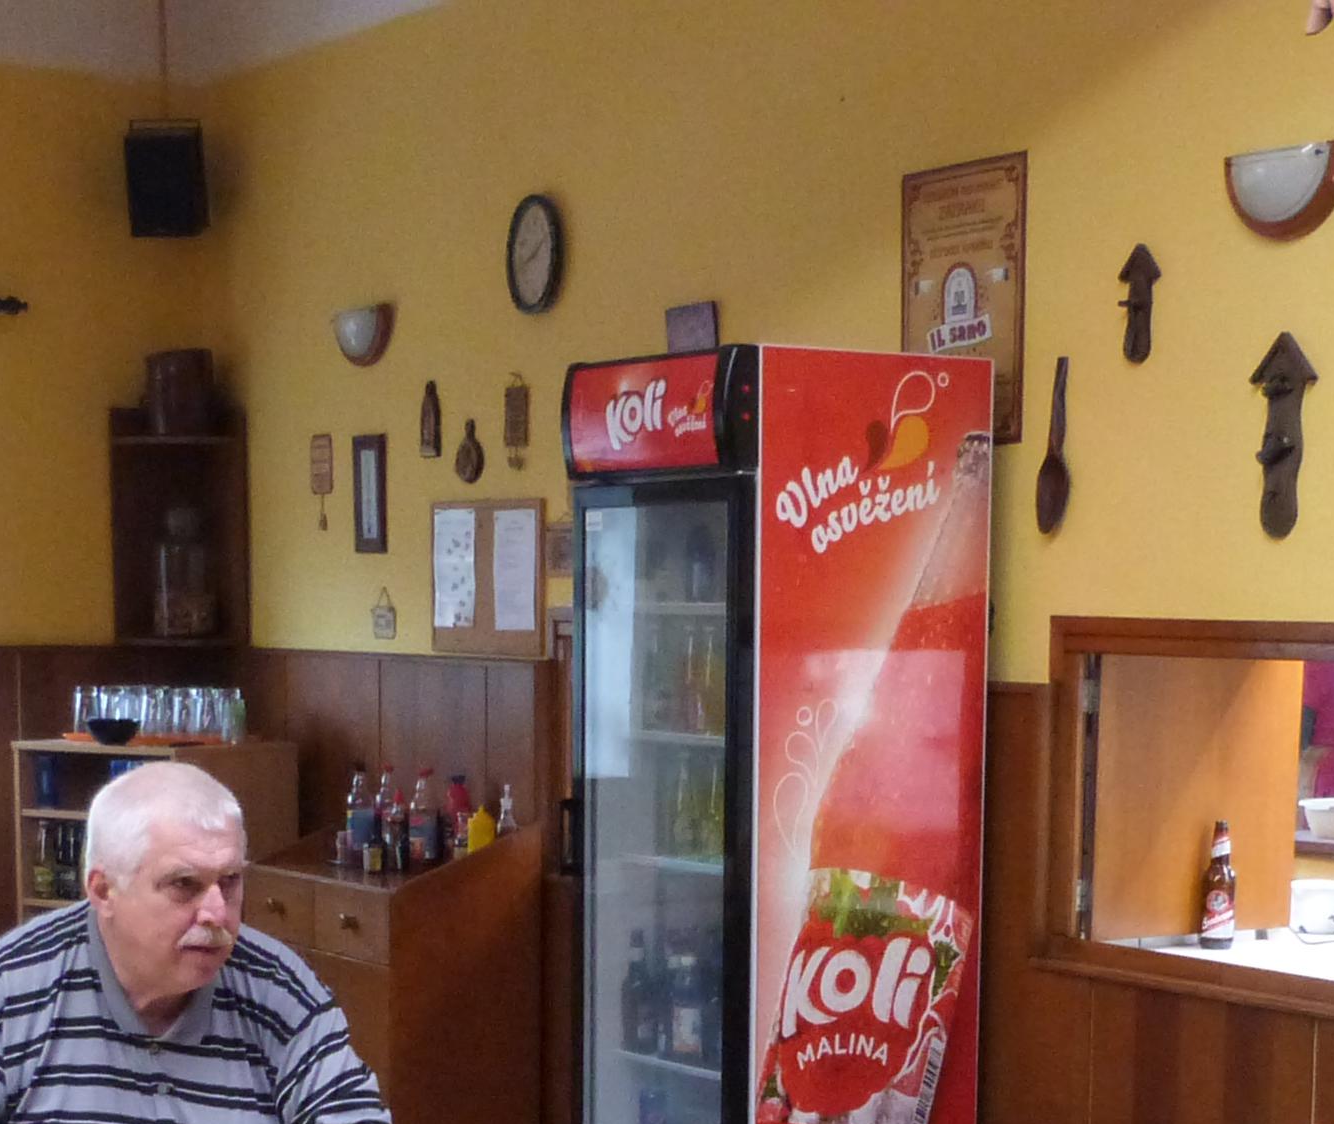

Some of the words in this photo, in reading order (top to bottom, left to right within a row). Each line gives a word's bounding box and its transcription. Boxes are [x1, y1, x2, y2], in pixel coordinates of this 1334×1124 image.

[606, 378, 666, 451] Koli
[776, 456, 859, 528] Vlna
[811, 460, 941, 554] osvěžení
[782, 937, 931, 1038] Koli
[796, 1032, 888, 1070] MALINA
